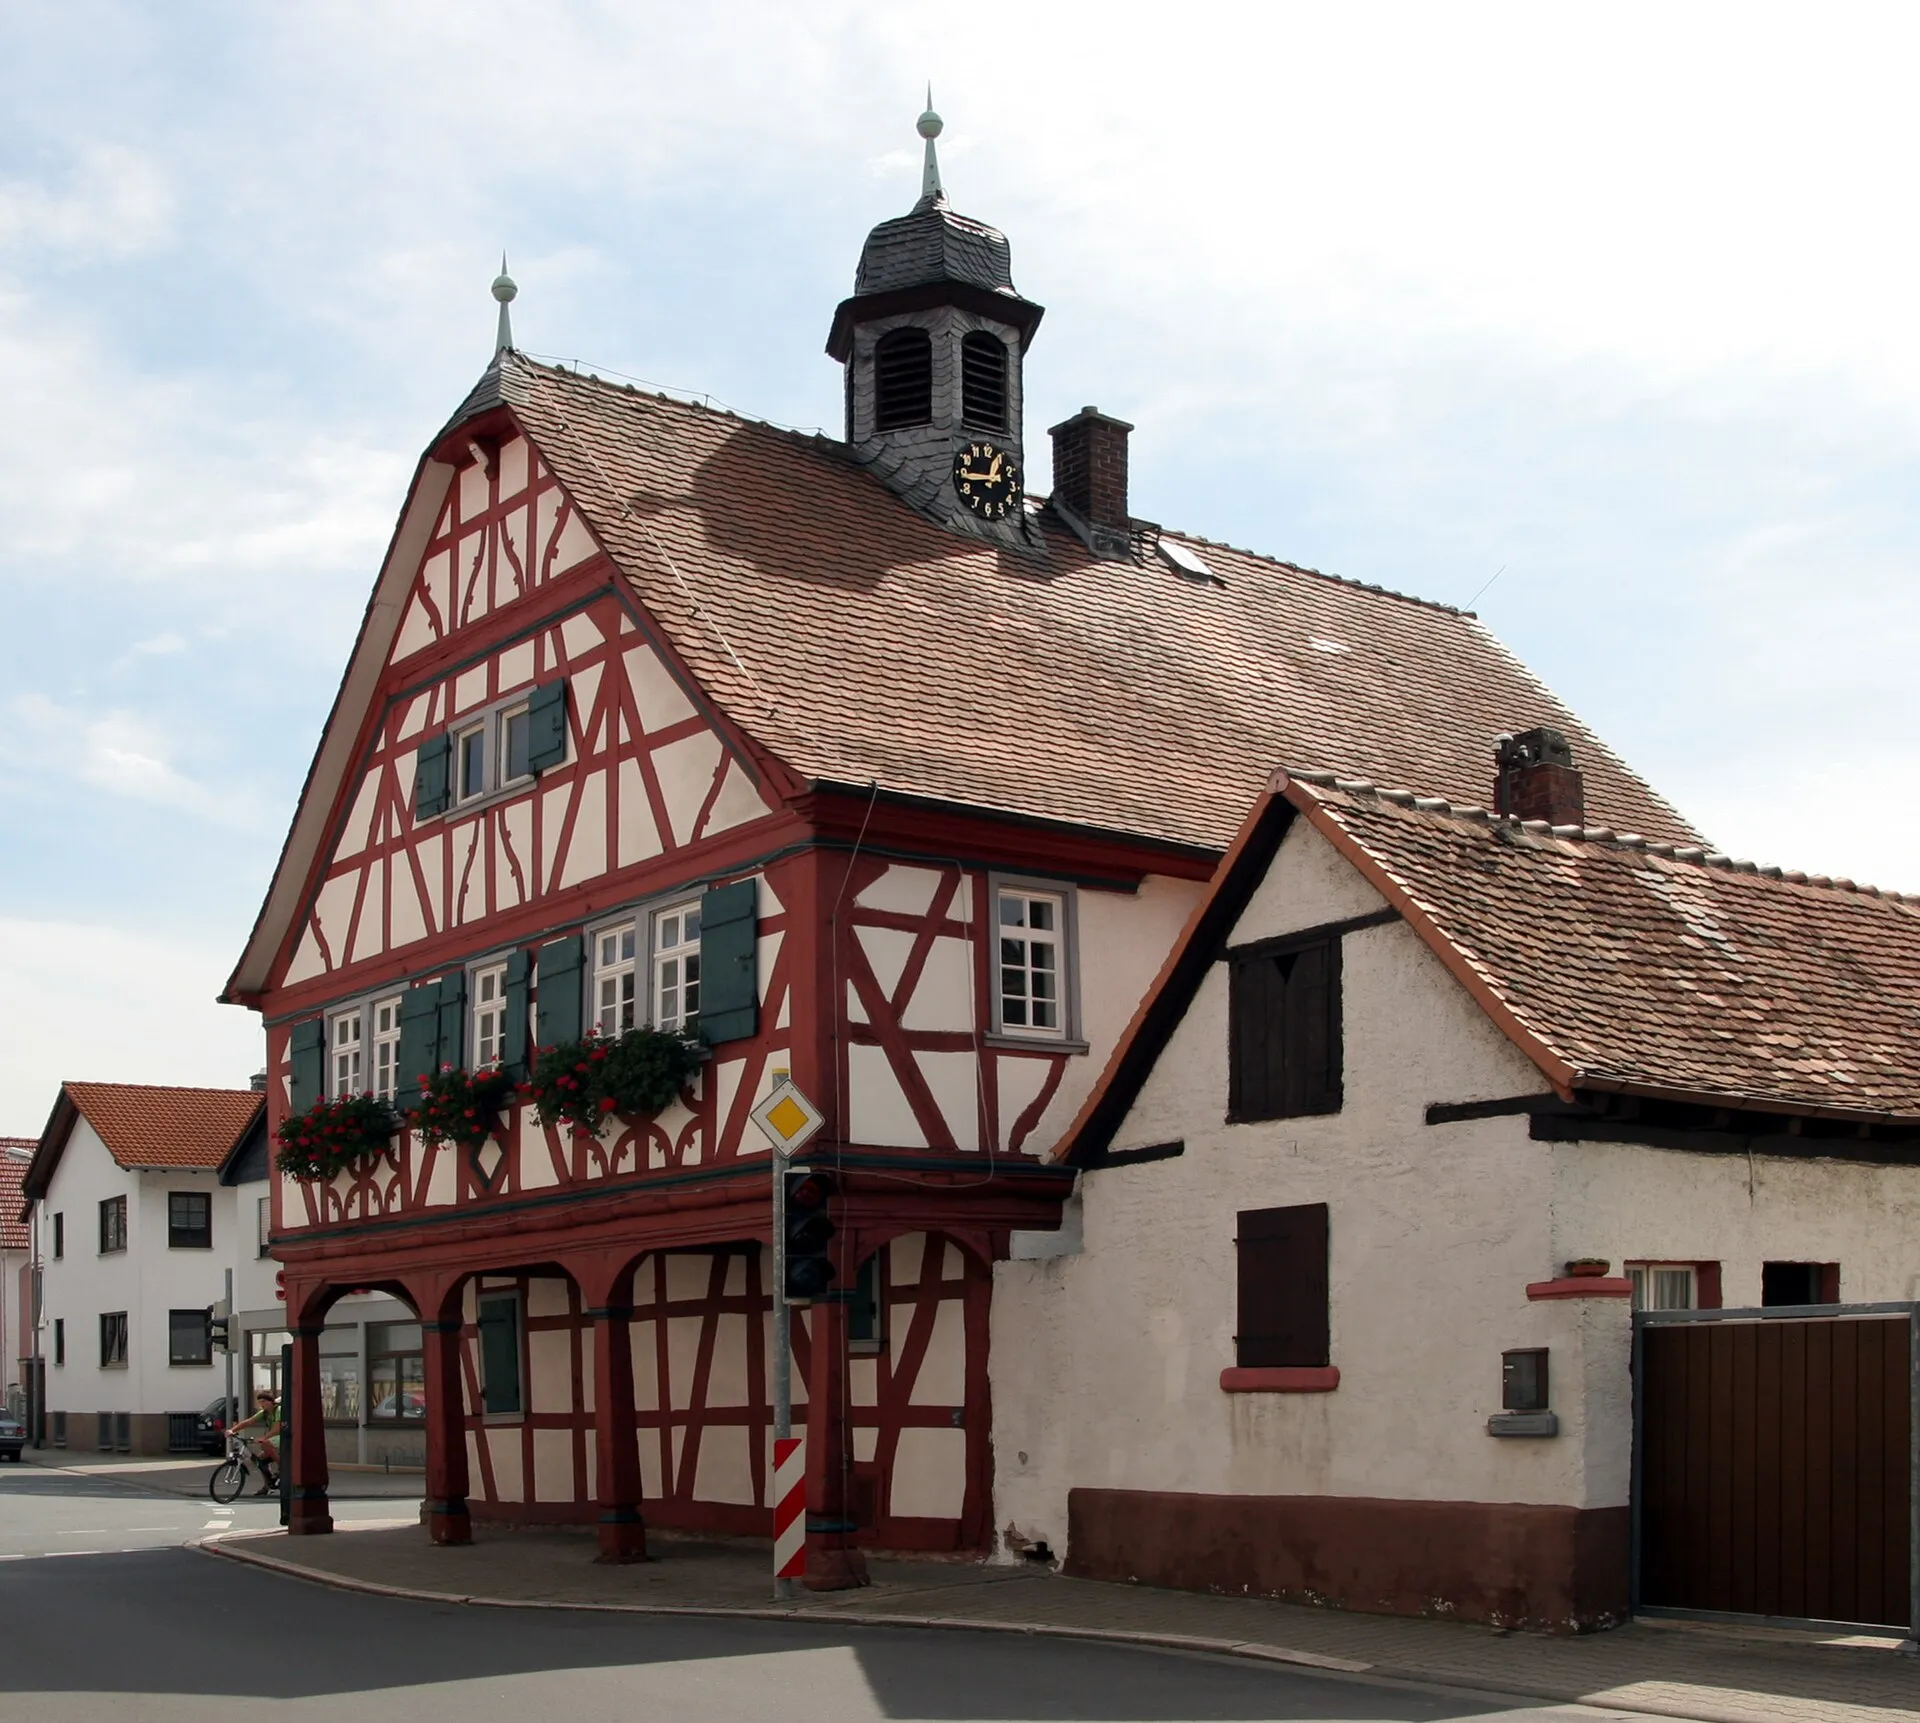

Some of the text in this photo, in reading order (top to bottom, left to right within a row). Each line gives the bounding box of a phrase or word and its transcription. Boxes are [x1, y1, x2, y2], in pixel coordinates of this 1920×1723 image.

[972, 446, 979, 458] 11
[983, 446, 993, 458] 12
[962, 454, 972, 466] 10
[1006, 465, 1013, 477] 2
[963, 482, 971, 495] 8
[1009, 481, 1016, 492] 3
[972, 496, 980, 507] 7
[1005, 494, 1013, 506] 4
[984, 502, 992, 514] 6
[997, 502, 1004, 514] 5
